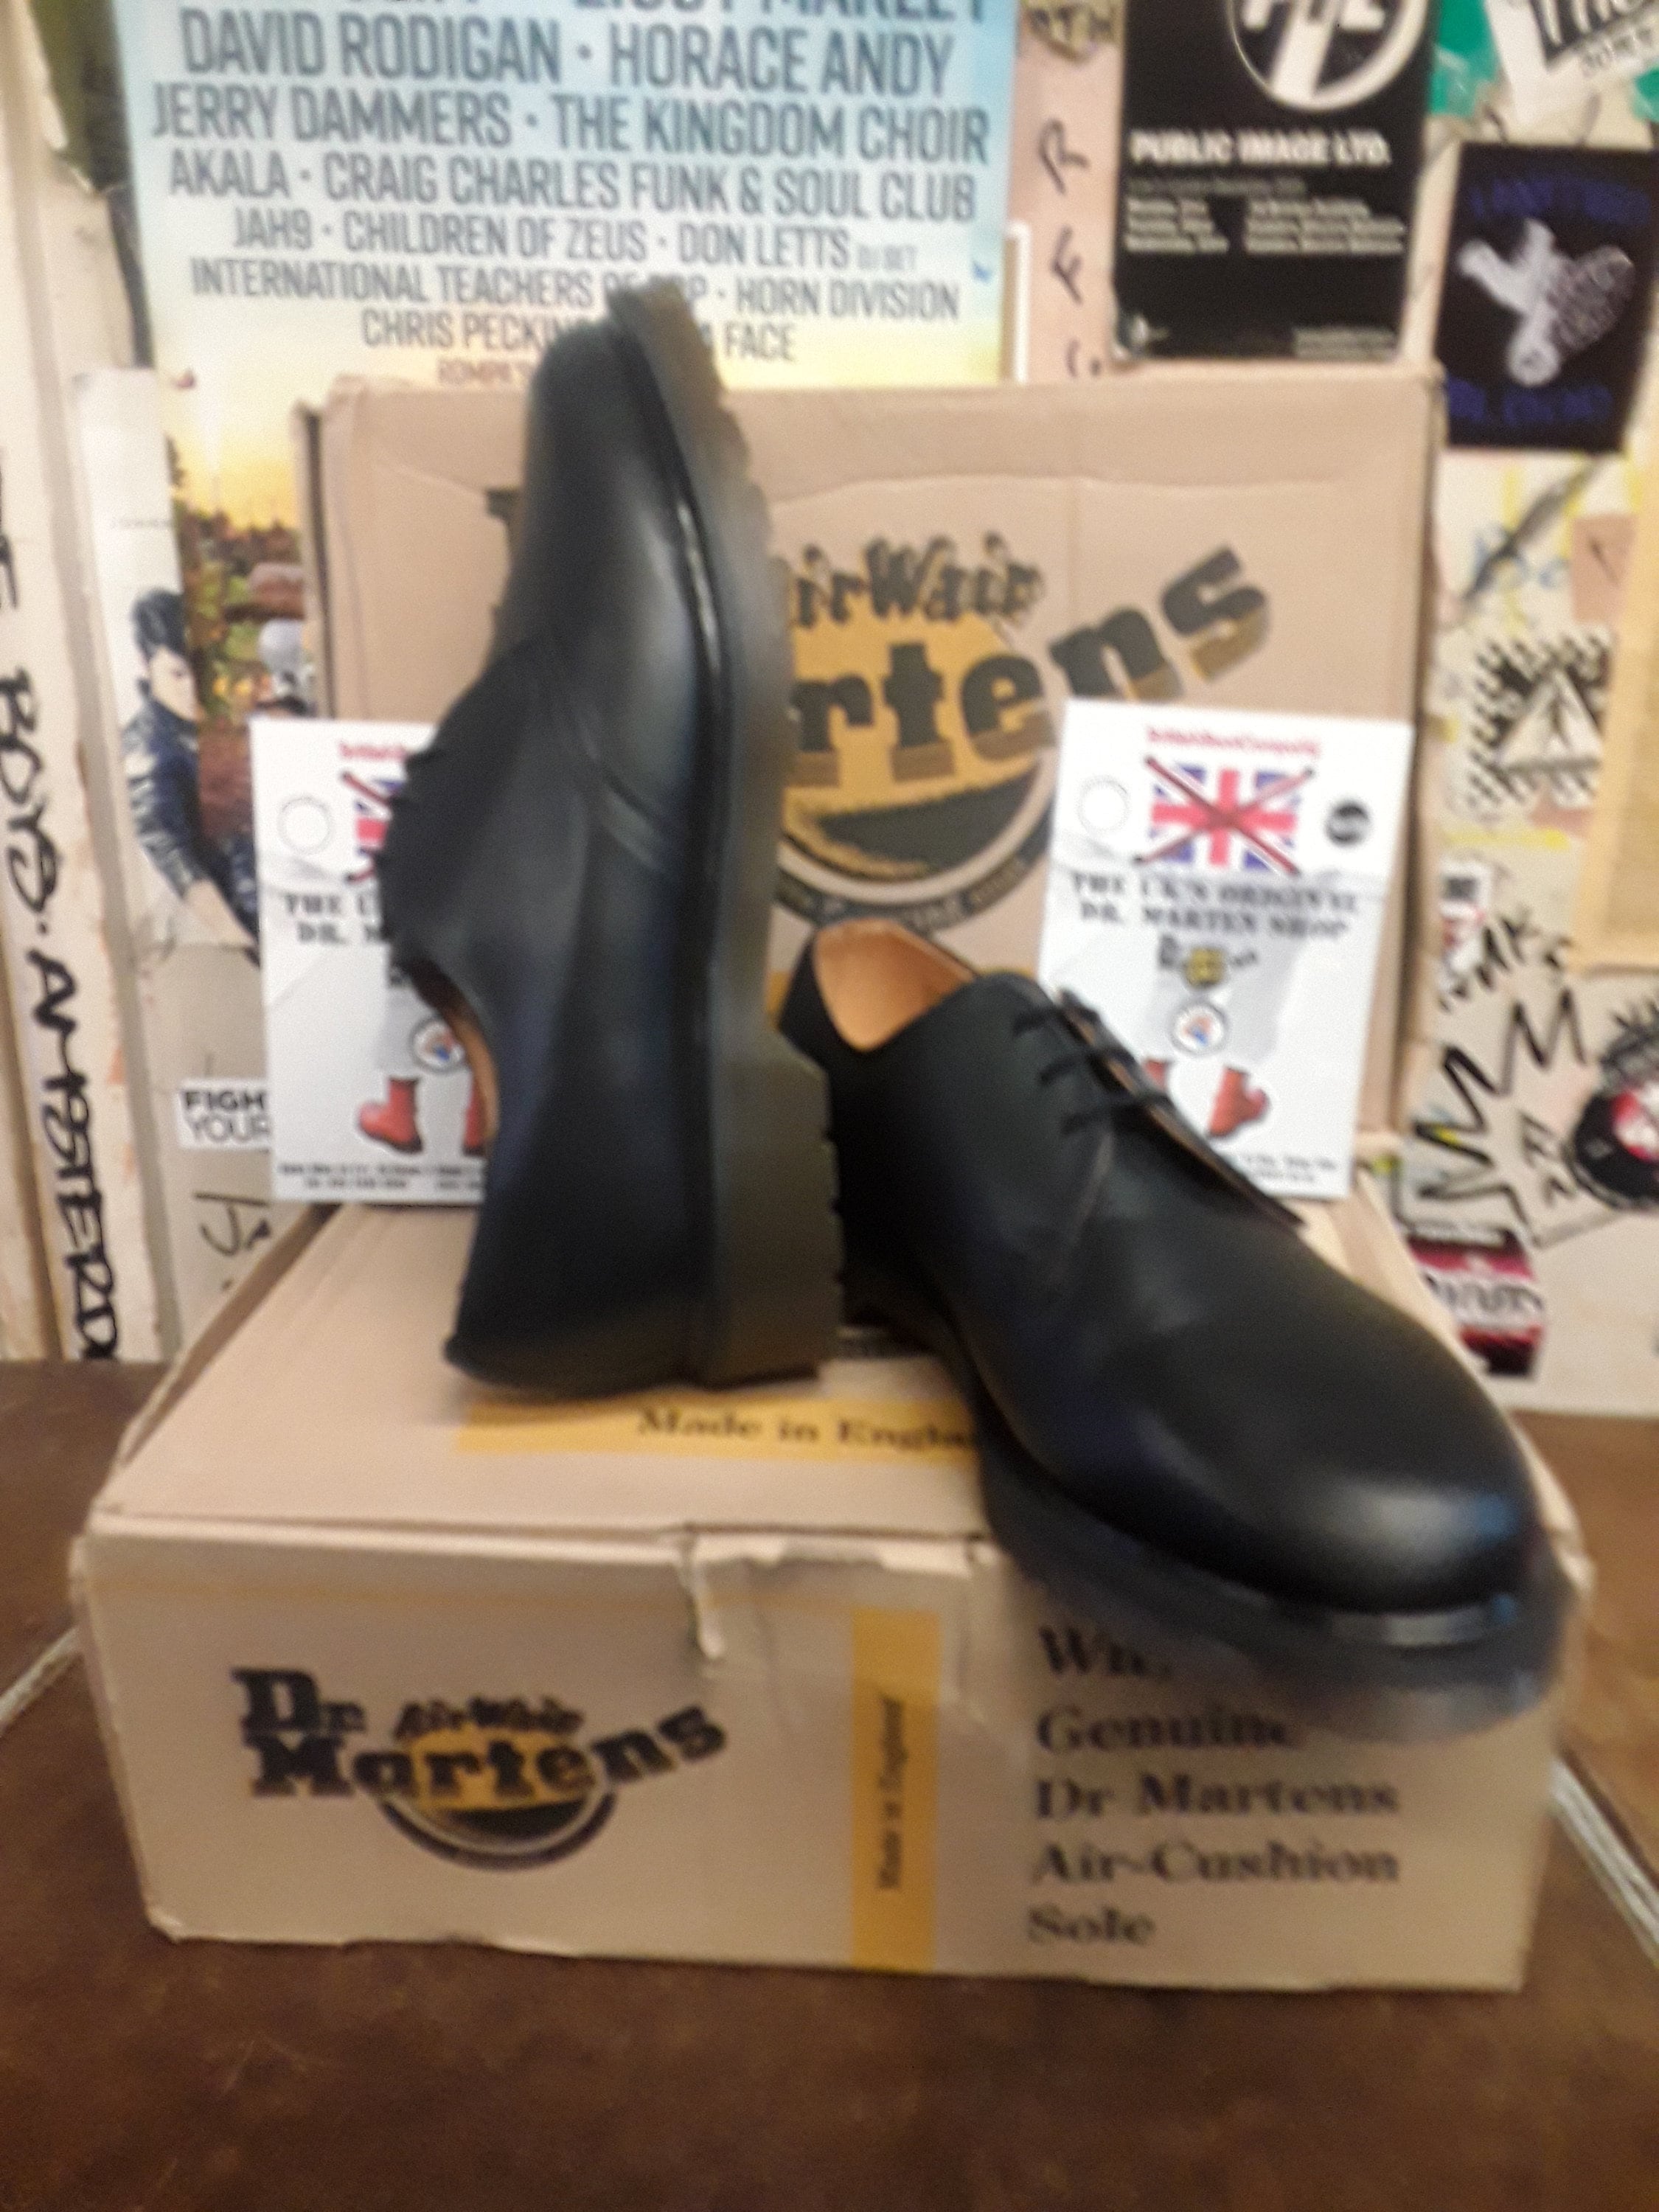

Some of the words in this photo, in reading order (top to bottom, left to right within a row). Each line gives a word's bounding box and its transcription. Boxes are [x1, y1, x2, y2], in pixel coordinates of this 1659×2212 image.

[180, 8, 325, 75] DAVID
[338, 13, 561, 84] RODIGAN
[608, 22, 810, 93] HORACE
[818, 30, 956, 98] ANDY
[152, 82, 279, 140] JERRY
[289, 85, 514, 148] DAMMERS
[549, 93, 630, 153] THE
[643, 96, 846, 159] KINGDOM
[856, 103, 991, 166] CHOIR
[1129, 127, 1234, 167] PUBLIC
[1237, 127, 1329, 167] IMAGE
[170, 147, 291, 199] AKALA
[322, 151, 438, 204] CRAIG
[446, 153, 621, 210] CHARLES
[629, 160, 730, 215] FUNK
[738, 165, 765, 215] &
[773, 165, 871, 220] SOUL
[879, 169, 977, 222] CLUB
[232, 206, 313, 251] JAH9
[343, 209, 508, 257] CHILDREN
[516, 214, 556, 260] OF
[565, 219, 648, 264] ZEUS
[678, 222, 747, 267] DON
[755, 225, 852, 270] LETTS
[190, 255, 430, 303] INTERNATIONAL
[439, 262, 596, 310] TEACHERS
[734, 276, 820, 319] HORN
[828, 279, 961, 321] DIVISION
[361, 307, 455, 349] CHRIS
[723, 321, 798, 363] FACE
[772, 529, 1046, 630] irWair
[787, 544, 1273, 787] rtens
[182, 1090, 267, 1110] FIGH
[637, 1407, 764, 1439] Made
[778, 1416, 819, 1442] in
[836, 1419, 969, 1451] Engla
[230, 1666, 366, 1733] Dr
[242, 1703, 727, 1798] Martens
[1037, 1776, 1113, 1819] Dr
[1137, 1773, 1399, 1815] Martens
[1033, 1841, 1399, 1885] Air-Cushion
[1027, 1904, 1157, 1946] Sole
